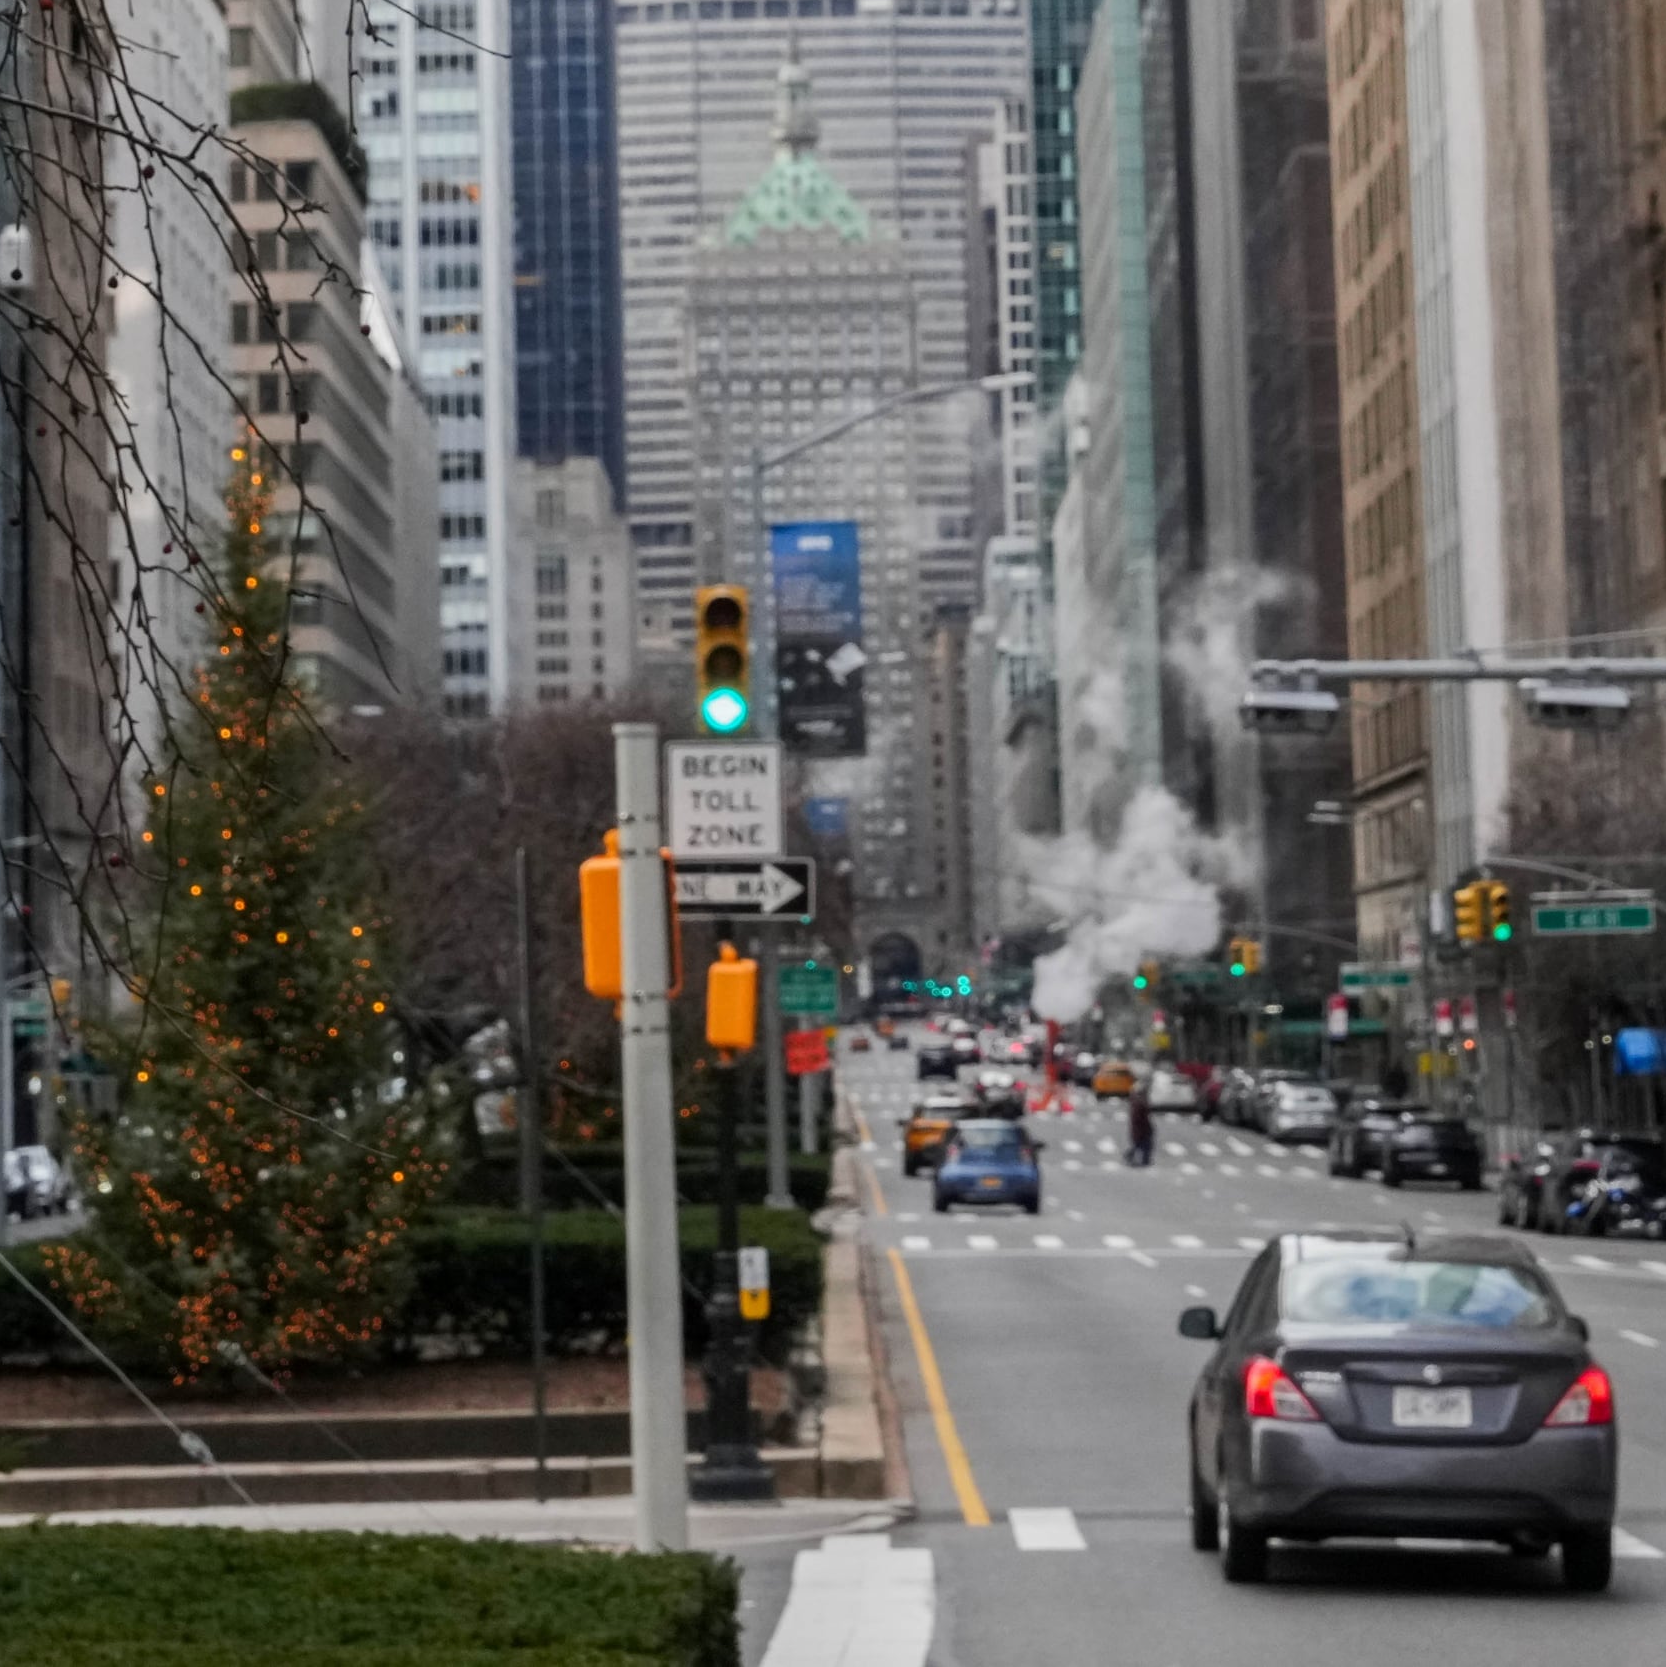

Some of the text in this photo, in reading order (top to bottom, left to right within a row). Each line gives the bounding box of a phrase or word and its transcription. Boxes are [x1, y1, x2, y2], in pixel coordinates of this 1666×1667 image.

[682, 755, 768, 778] BEGIN
[690, 789, 763, 812] TOLL
[687, 823, 764, 847] ZONE
